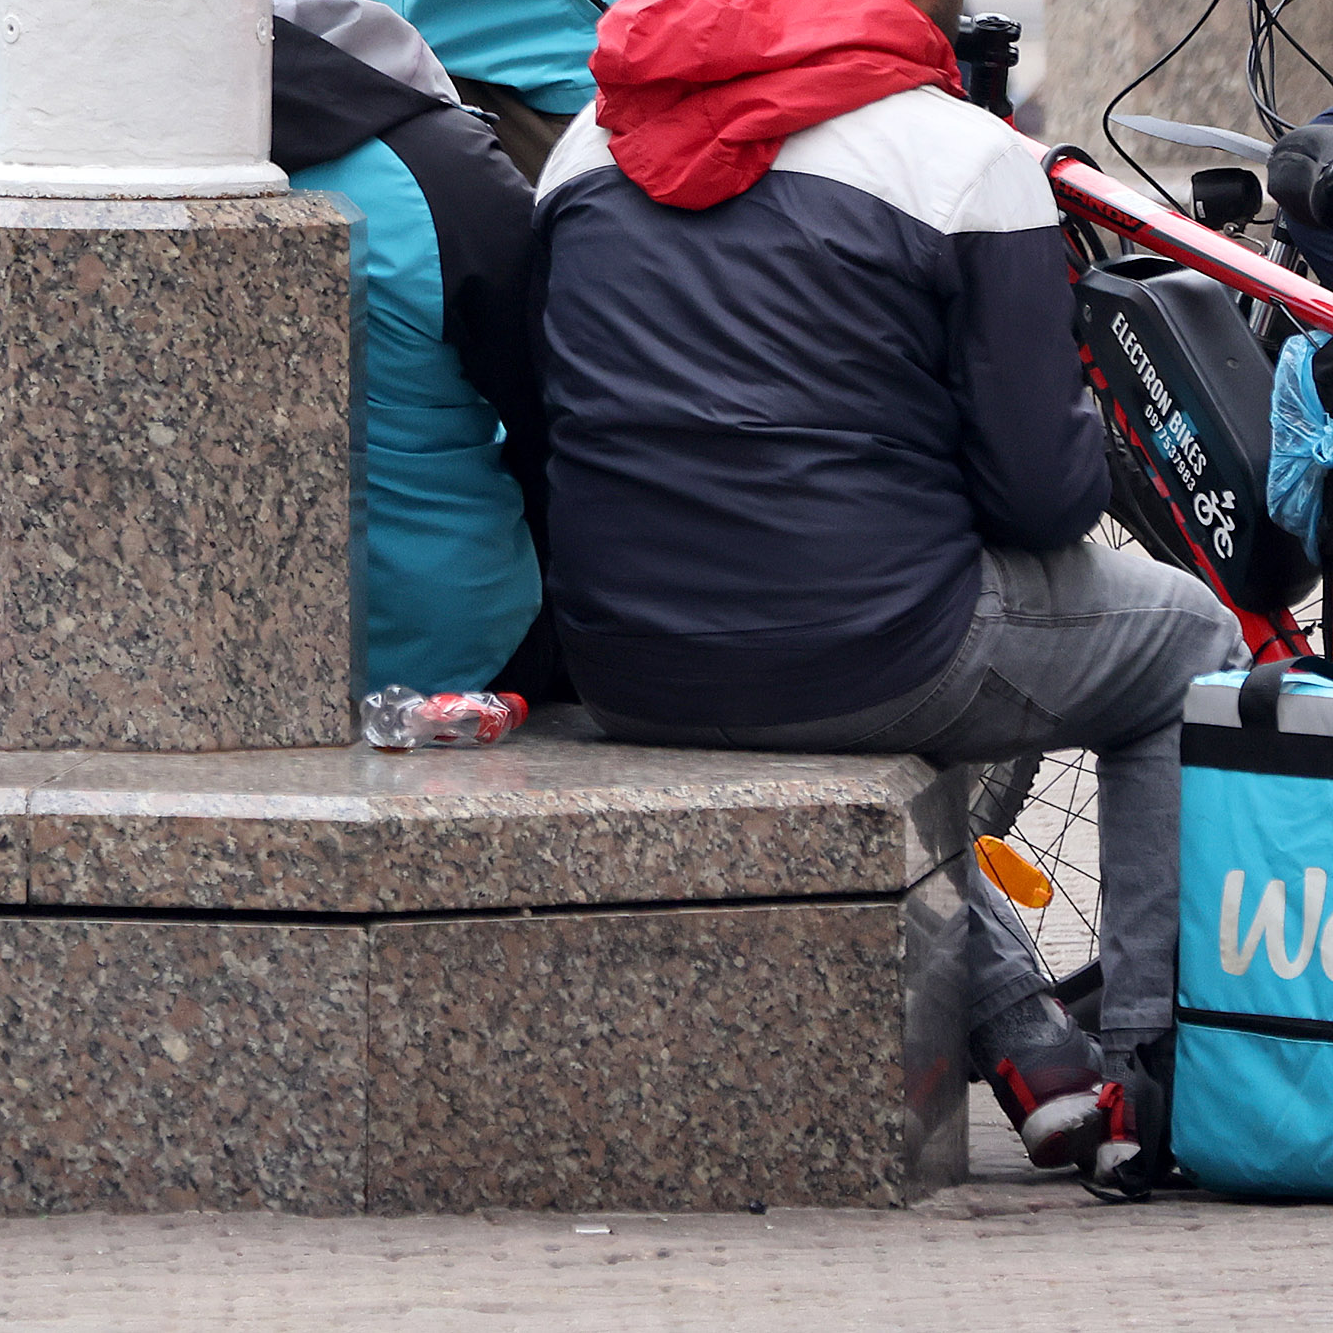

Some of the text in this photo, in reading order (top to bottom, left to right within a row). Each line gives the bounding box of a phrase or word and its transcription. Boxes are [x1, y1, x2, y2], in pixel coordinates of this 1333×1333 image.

[1111, 311, 1207, 476] ELECTRON BIKES
[1145, 404, 1196, 491] 0977537983
[1219, 867, 1333, 979] W
